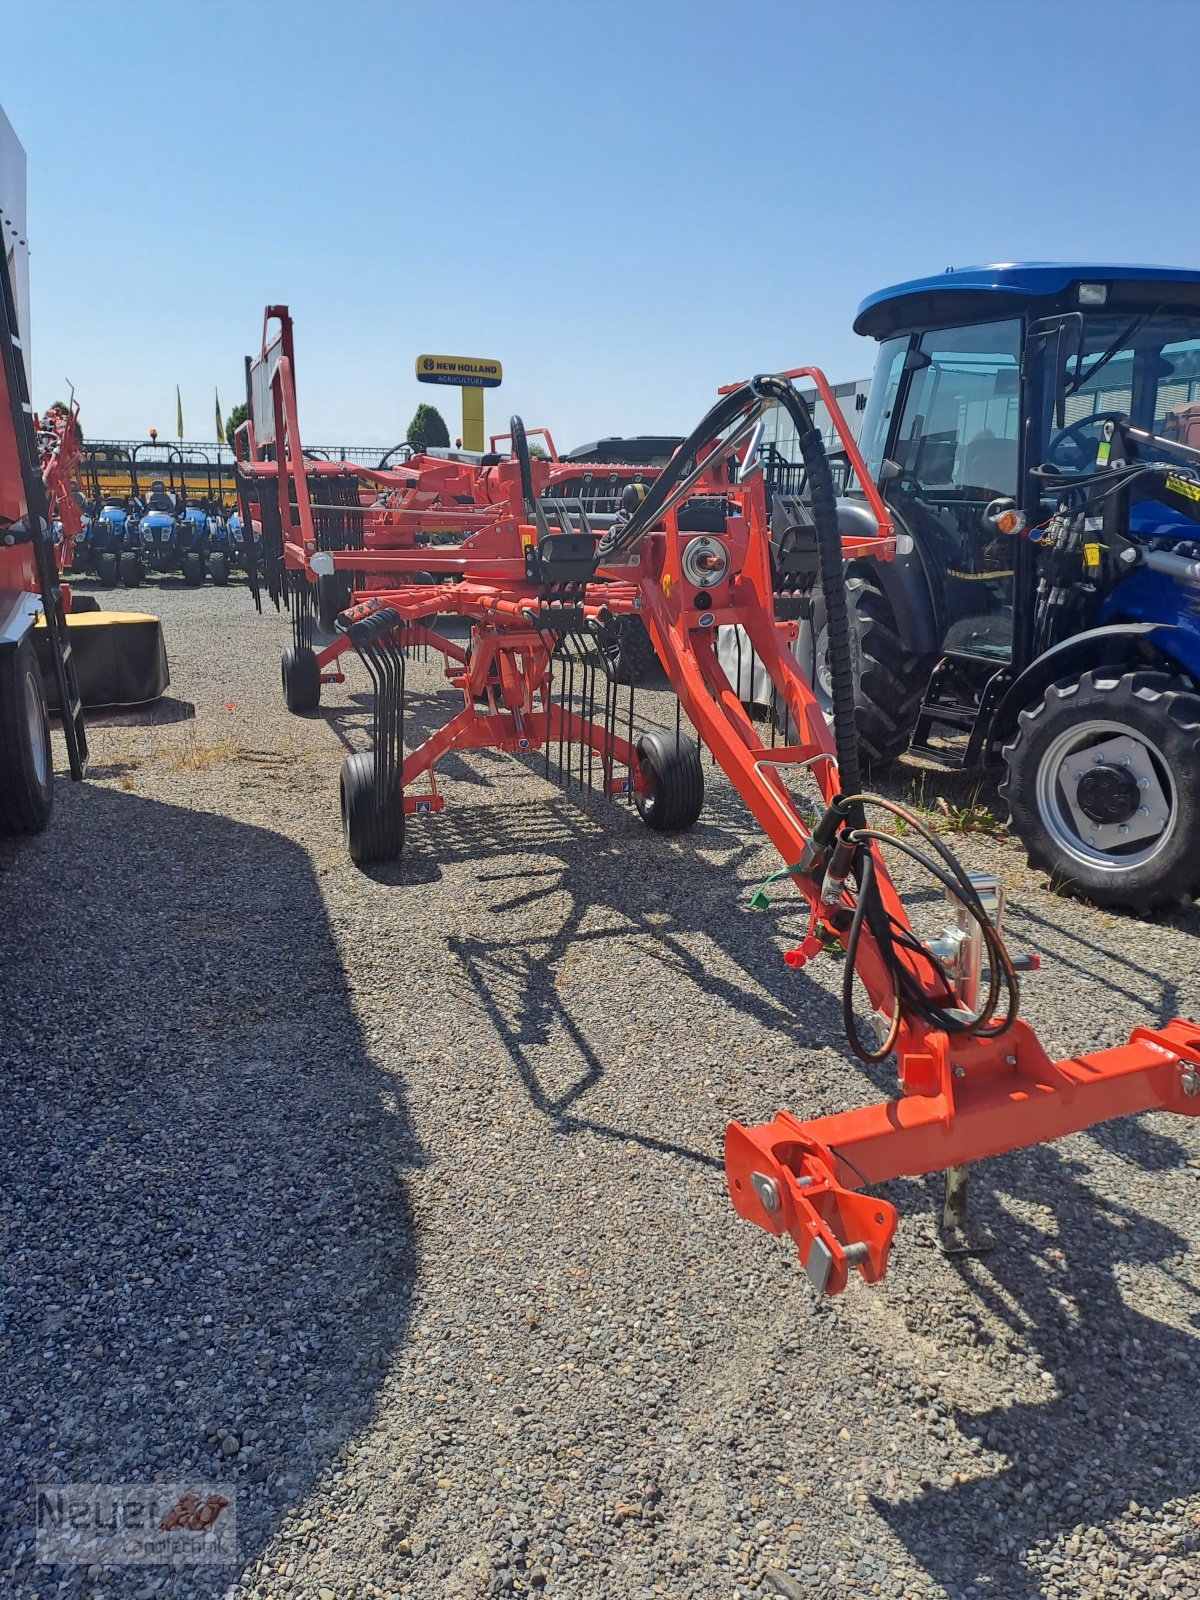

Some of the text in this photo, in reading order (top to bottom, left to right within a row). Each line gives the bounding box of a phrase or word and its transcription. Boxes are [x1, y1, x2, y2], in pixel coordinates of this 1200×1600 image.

[436, 362, 497, 374] NEW HOLLAND
[437, 375, 484, 385] AGRICULTURE
